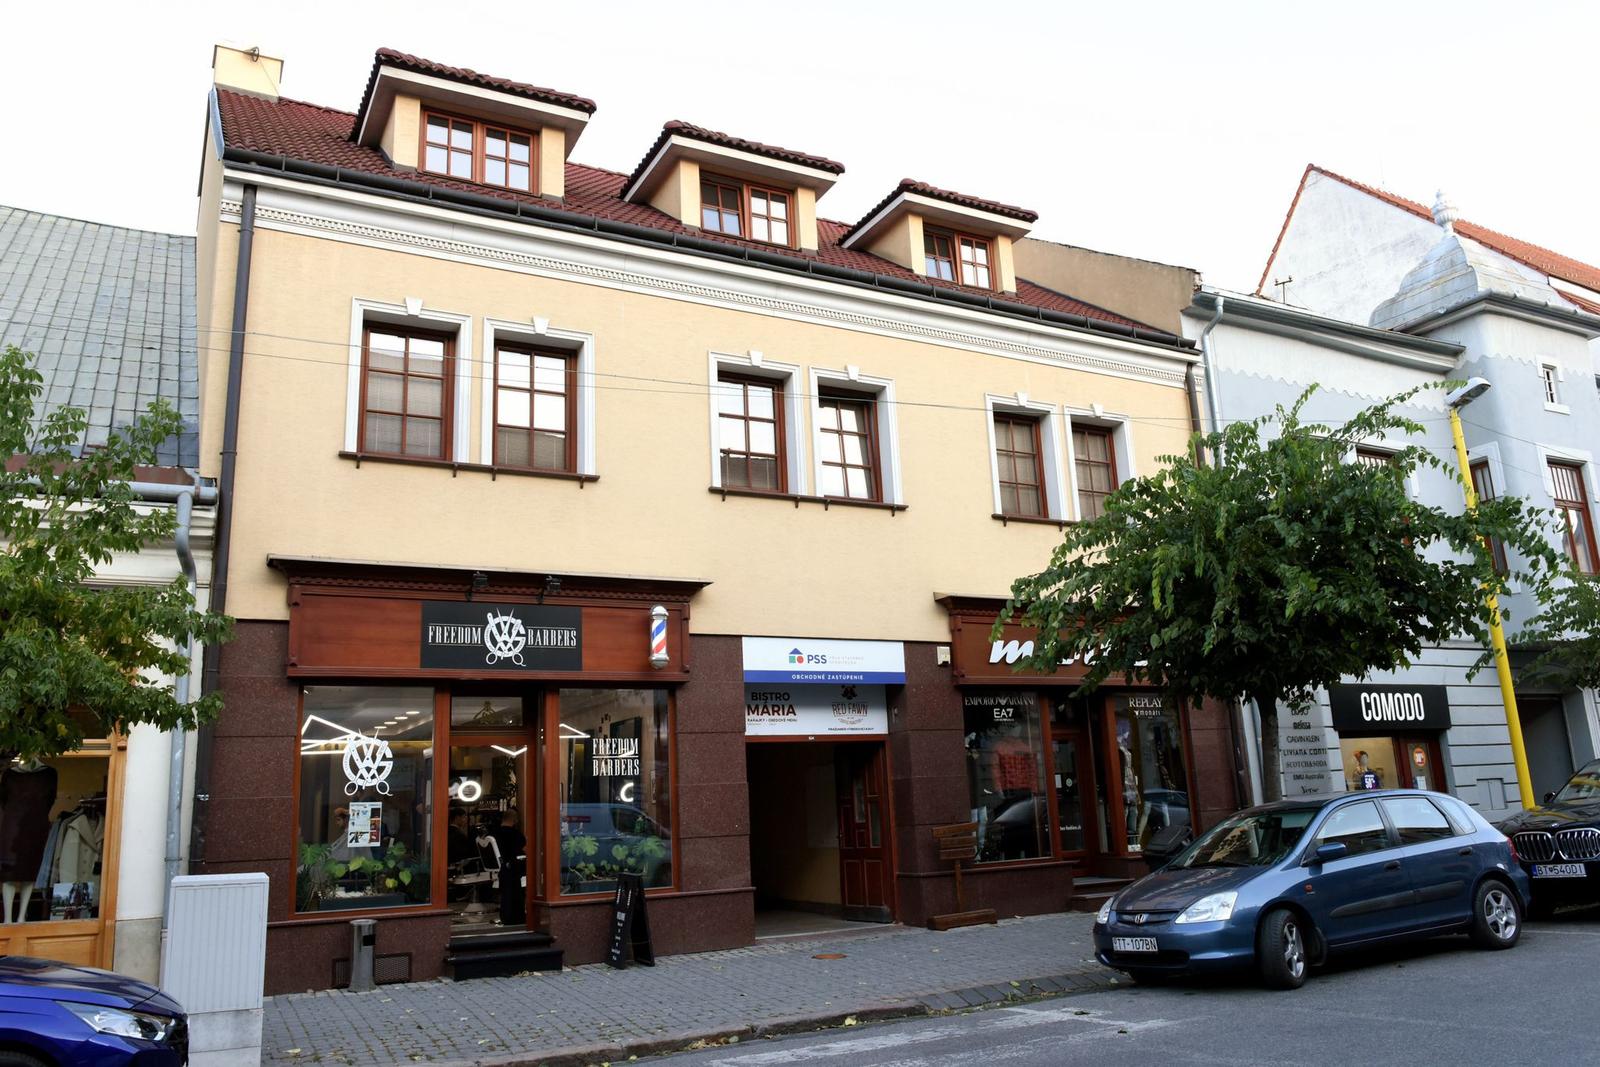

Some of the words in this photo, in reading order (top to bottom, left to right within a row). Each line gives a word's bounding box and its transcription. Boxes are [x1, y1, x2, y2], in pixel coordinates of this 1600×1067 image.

[428, 625, 482, 645] FREEDOM
[527, 628, 577, 647] BARBERS
[807, 655, 828, 664] PSS
[751, 692, 791, 701] BISTRO
[965, 697, 999, 706] EMPORIO
[1006, 697, 1034, 706] ARMANI
[1129, 697, 1163, 708] REPLAY
[747, 700, 797, 716] MÁRIA
[832, 703, 847, 716] RED
[848, 702, 868, 716] FAWN
[993, 708, 1014, 718] EA7
[1360, 692, 1425, 721] COMODO
[592, 738, 639, 755] FREEDOM
[592, 759, 640, 777] BARBERS
